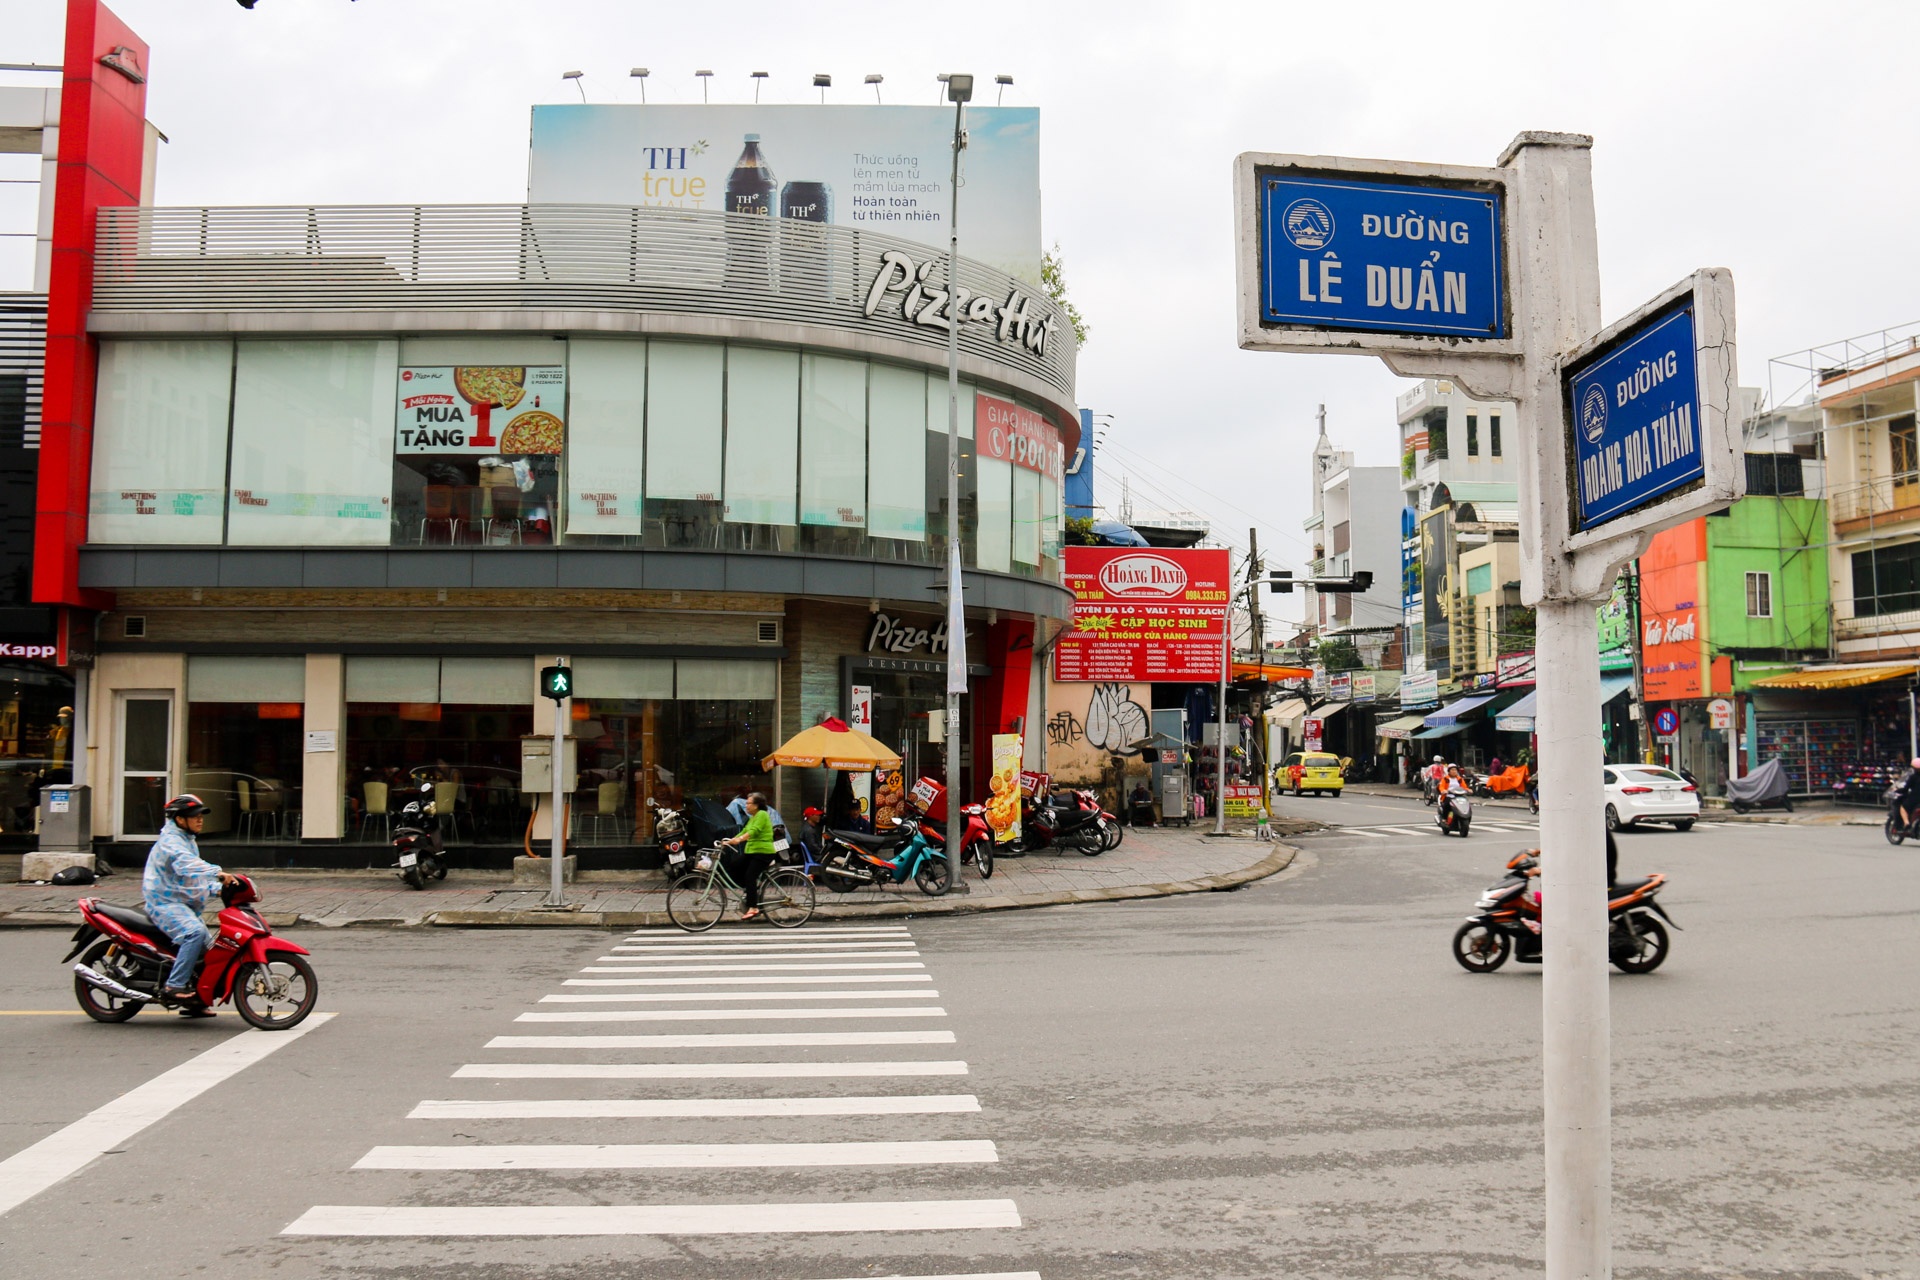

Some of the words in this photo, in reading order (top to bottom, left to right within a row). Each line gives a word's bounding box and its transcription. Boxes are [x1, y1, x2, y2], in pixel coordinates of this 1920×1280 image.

[643, 147, 688, 170] TH
[853, 153, 884, 165] Thức
[887, 154, 918, 168] uống
[853, 168, 872, 179] lên
[876, 170, 903, 179] men
[643, 171, 706, 197] true
[736, 195, 752, 204] TH
[853, 195, 885, 207] Hoàn
[889, 196, 917, 207] toàn
[736, 203, 768, 216] true
[790, 206, 808, 217] TH
[853, 210, 866, 221] từ
[869, 209, 901, 221] thiên
[905, 210, 940, 221] nhiên
[1361, 209, 1469, 245] ĐƯỜNG
[1299, 251, 1342, 304] LÊ
[1366, 250, 1467, 315] DUẨN
[863, 250, 995, 331] Pizza
[996, 289, 1060, 357] Hut
[1616, 350, 1678, 408] ĐƯỜNG
[410, 395, 428, 406] Mỗi
[428, 395, 451, 405] Ngày
[416, 407, 464, 423] MUA
[469, 399, 496, 447] 1
[987, 406, 1019, 428] GIAO
[1021, 412, 1045, 442] HÀNG
[400, 424, 464, 451] TẶNG
[1007, 432, 1046, 471] 1900
[1583, 443, 1623, 504] HOÀNG
[1624, 426, 1652, 484] HOA
[1652, 401, 1694, 469] THÁM
[1107, 564, 1148, 583] HOÀNG
[1151, 565, 1183, 584] DANH
[1074, 580, 1087, 589] 51
[1088, 590, 1104, 600] THÁM
[1074, 605, 1102, 613] UYÊN
[1104, 606, 1119, 614] BA
[1121, 606, 1135, 614] LÔ
[1178, 606, 1195, 615] TÚI
[1197, 607, 1225, 615] XÁCH
[1148, 618, 1175, 629] HỌC
[1178, 619, 1208, 628] SINH
[868, 613, 929, 653] Pizza
[1098, 631, 1109, 640] HỆ
[1111, 630, 1142, 639] THỐNG
[1144, 630, 1161, 639] CỬA
[1163, 631, 1188, 640] HÀNG
[0, 643, 56, 658] Kapp
[868, 658, 974, 674] RESTAURT
[861, 700, 870, 724] 1
[889, 775, 900, 786] 69
